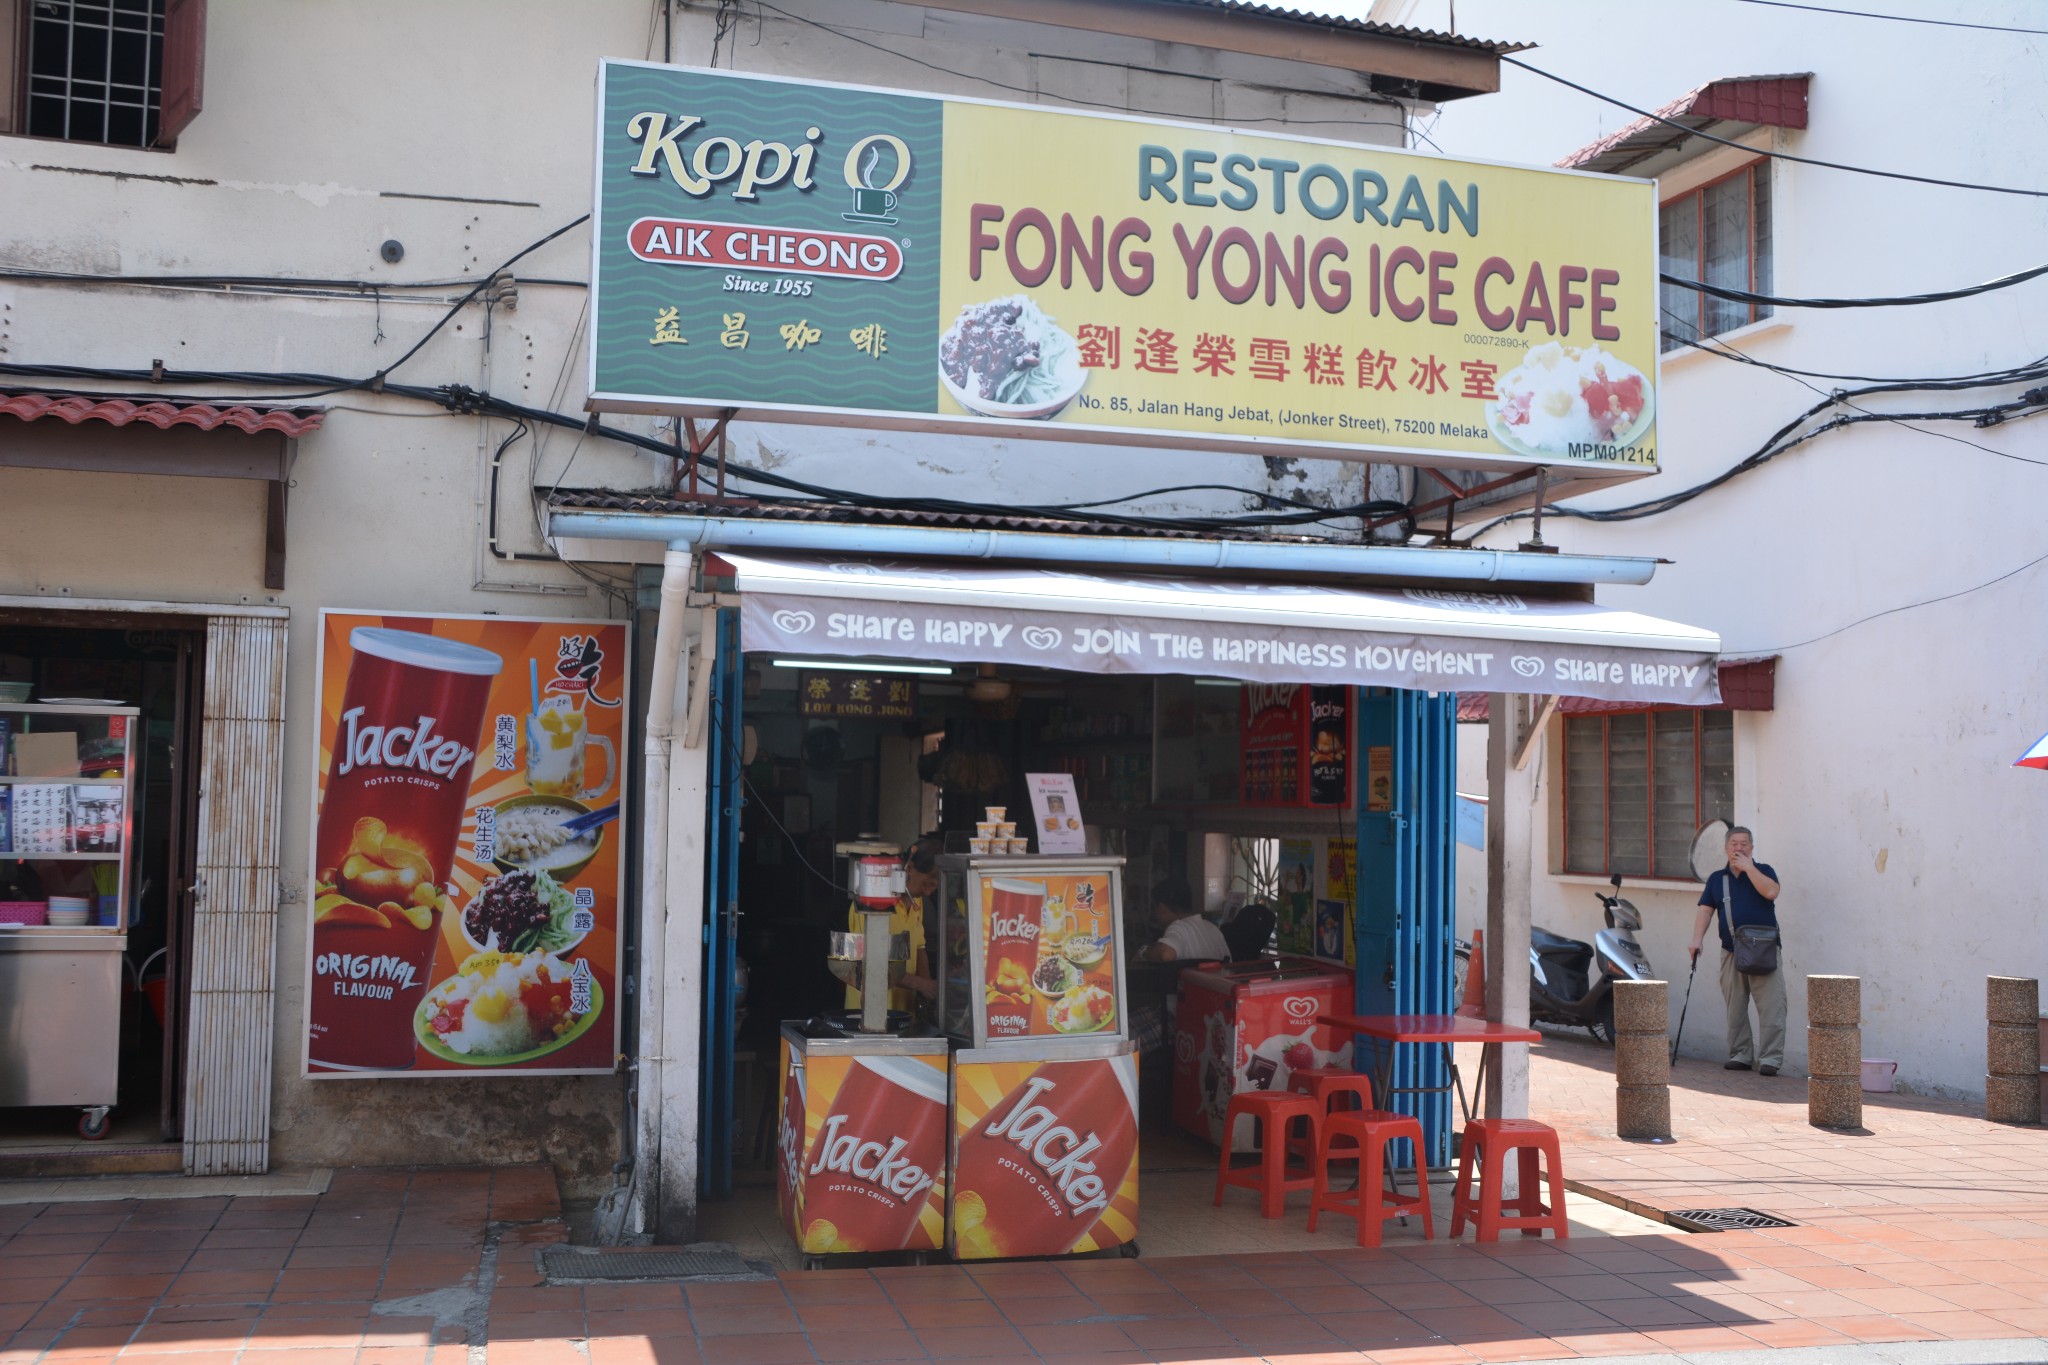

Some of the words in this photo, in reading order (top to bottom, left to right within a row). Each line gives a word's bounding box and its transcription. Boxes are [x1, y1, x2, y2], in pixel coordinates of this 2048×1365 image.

[627, 111, 823, 200] Kopi
[843, 134, 913, 192] O
[1138, 144, 1479, 238] RESTORAN
[643, 226, 713, 259] AIK
[725, 231, 888, 272] CHEONG
[969, 202, 1155, 297] FONG
[1172, 222, 1352, 314] YONG
[1369, 242, 1458, 326] ICE
[1474, 256, 1620, 342] CAFE
[722, 274, 769, 294] Since
[772, 277, 814, 297] 1955
[649, 306, 888, 360] 益昌咖啡
[1463, 333, 1530, 350] 000072890-K
[1076, 323, 1500, 401] 劉逢榮雪糕飲冰室
[1078, 394, 1104, 410] No.
[1109, 396, 1133, 413] 85,
[1137, 398, 1179, 416] Jalan
[1183, 401, 1224, 421] Hang
[1228, 405, 1274, 425] Jebat,
[1278, 409, 1335, 427] (Jonker
[1339, 414, 1391, 434] Street),
[1394, 418, 1436, 435] 75200
[1439, 422, 1489, 439] Melaka
[1567, 442, 1656, 464] MPM01214
[1071, 627, 1142, 655] JOIN
[339, 706, 475, 780] Jacker
[496, 716, 514, 768] 黄梨水
[364, 775, 405, 789] POTATO
[407, 776, 441, 790] CRISPS
[475, 808, 493, 860] 花生汤
[990, 910, 1041, 941] Jacker
[316, 952, 423, 990] ORIGINAL
[334, 981, 394, 1000] FLAVOUR
[572, 959, 590, 1012] 八宝冰
[810, 1114, 935, 1203] Jacker
[986, 1076, 1109, 1217] Jacker
[828, 1184, 865, 1195] POTATO
[867, 1190, 896, 1209] CRISPS
[997, 1156, 1037, 1185] POTATO
[1037, 1184, 1063, 1218] CRISPS
